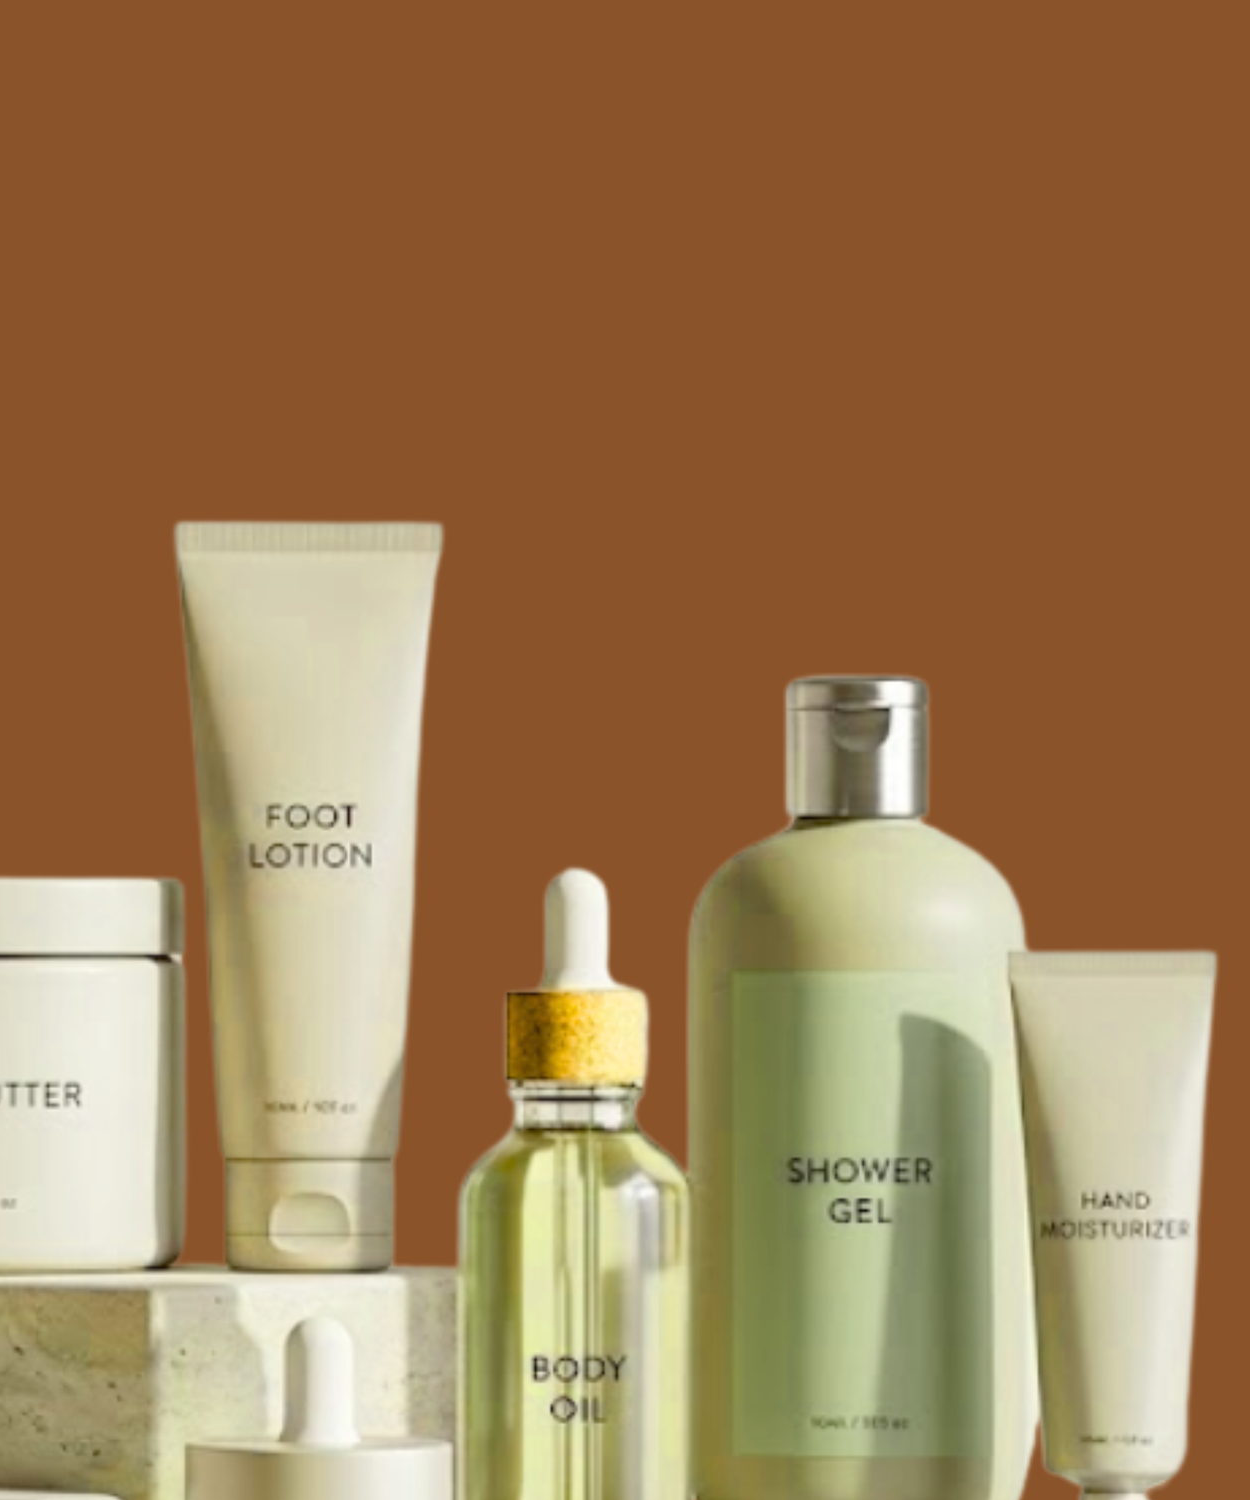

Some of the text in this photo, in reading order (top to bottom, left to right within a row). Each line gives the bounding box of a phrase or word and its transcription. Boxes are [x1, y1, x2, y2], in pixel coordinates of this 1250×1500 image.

[265, 804, 357, 829] FOOT
[249, 843, 372, 868] LOTION
[787, 1157, 933, 1184] SHOWER
[828, 1198, 893, 1224] GEL
[1081, 1192, 1152, 1211] HAND
[1040, 1220, 1190, 1241] MOISTURIZER
[532, 1355, 627, 1382] BODY
[549, 1395, 607, 1423] OIL
